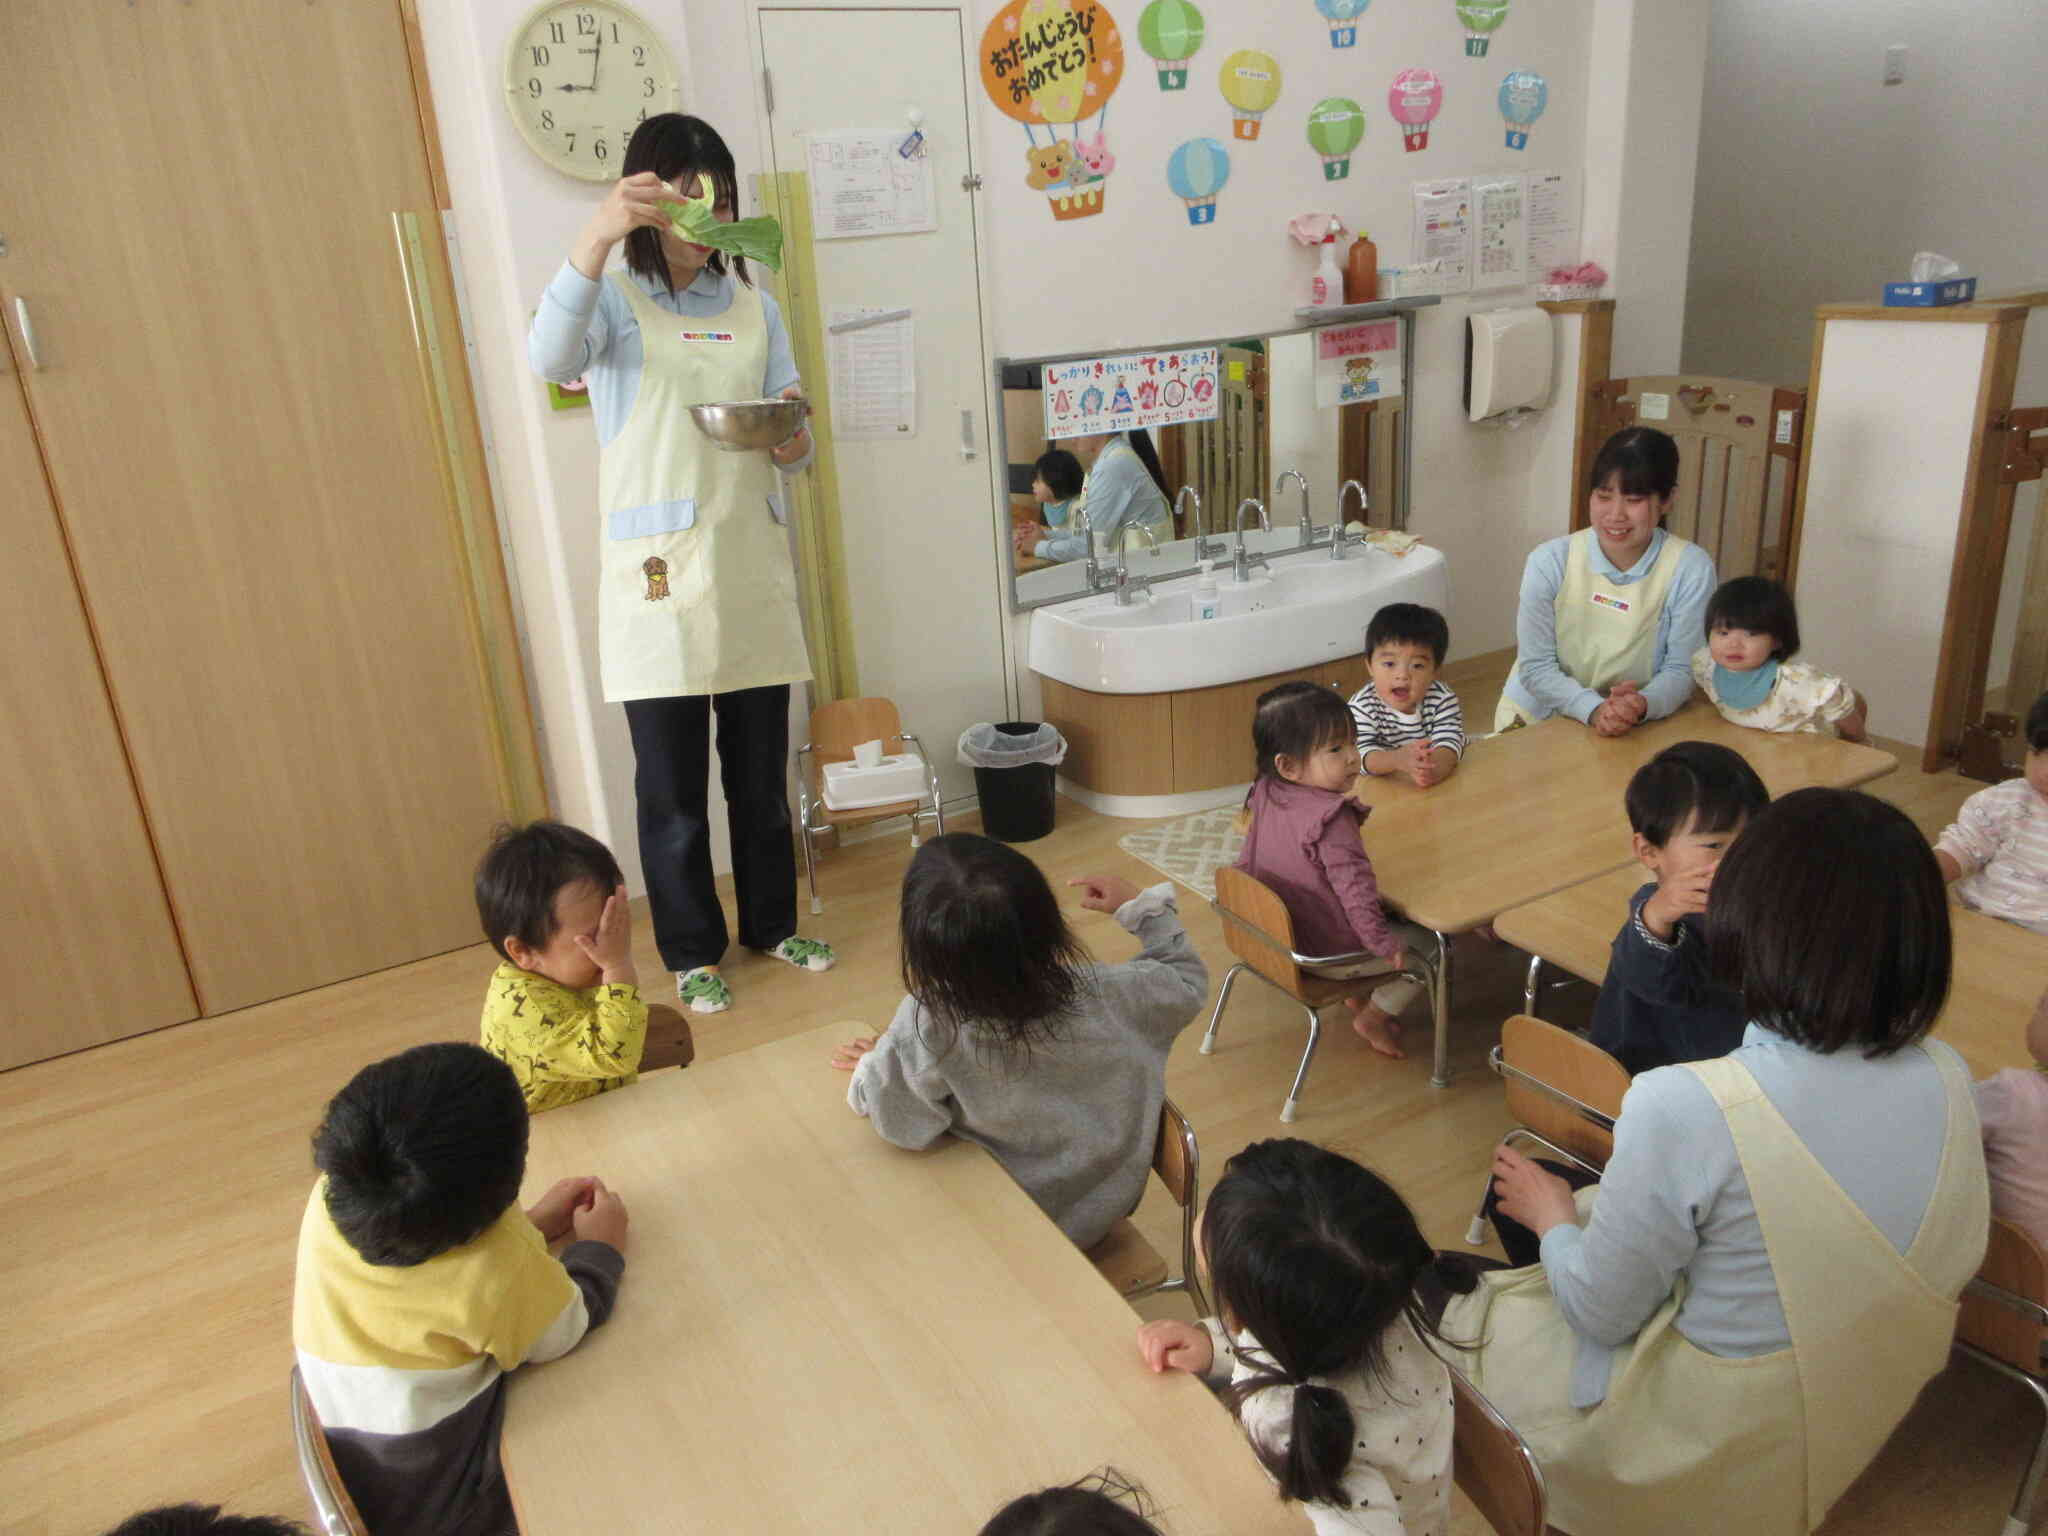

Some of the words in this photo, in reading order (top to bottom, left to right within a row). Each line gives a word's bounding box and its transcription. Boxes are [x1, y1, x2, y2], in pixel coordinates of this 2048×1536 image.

[551, 22, 566, 44] 11
[576, 14, 595, 35] 12
[610, 23, 620, 44] 1
[990, 6, 1096, 78] おたんじょうび
[532, 46, 550, 67] 10
[632, 46, 645, 67] 2
[529, 78, 542, 99] 9
[643, 77, 655, 98] 3
[1167, 71, 1179, 88] 4
[541, 110, 554, 130] 8
[565, 132, 576, 153] 7
[595, 139, 607, 160] 6
